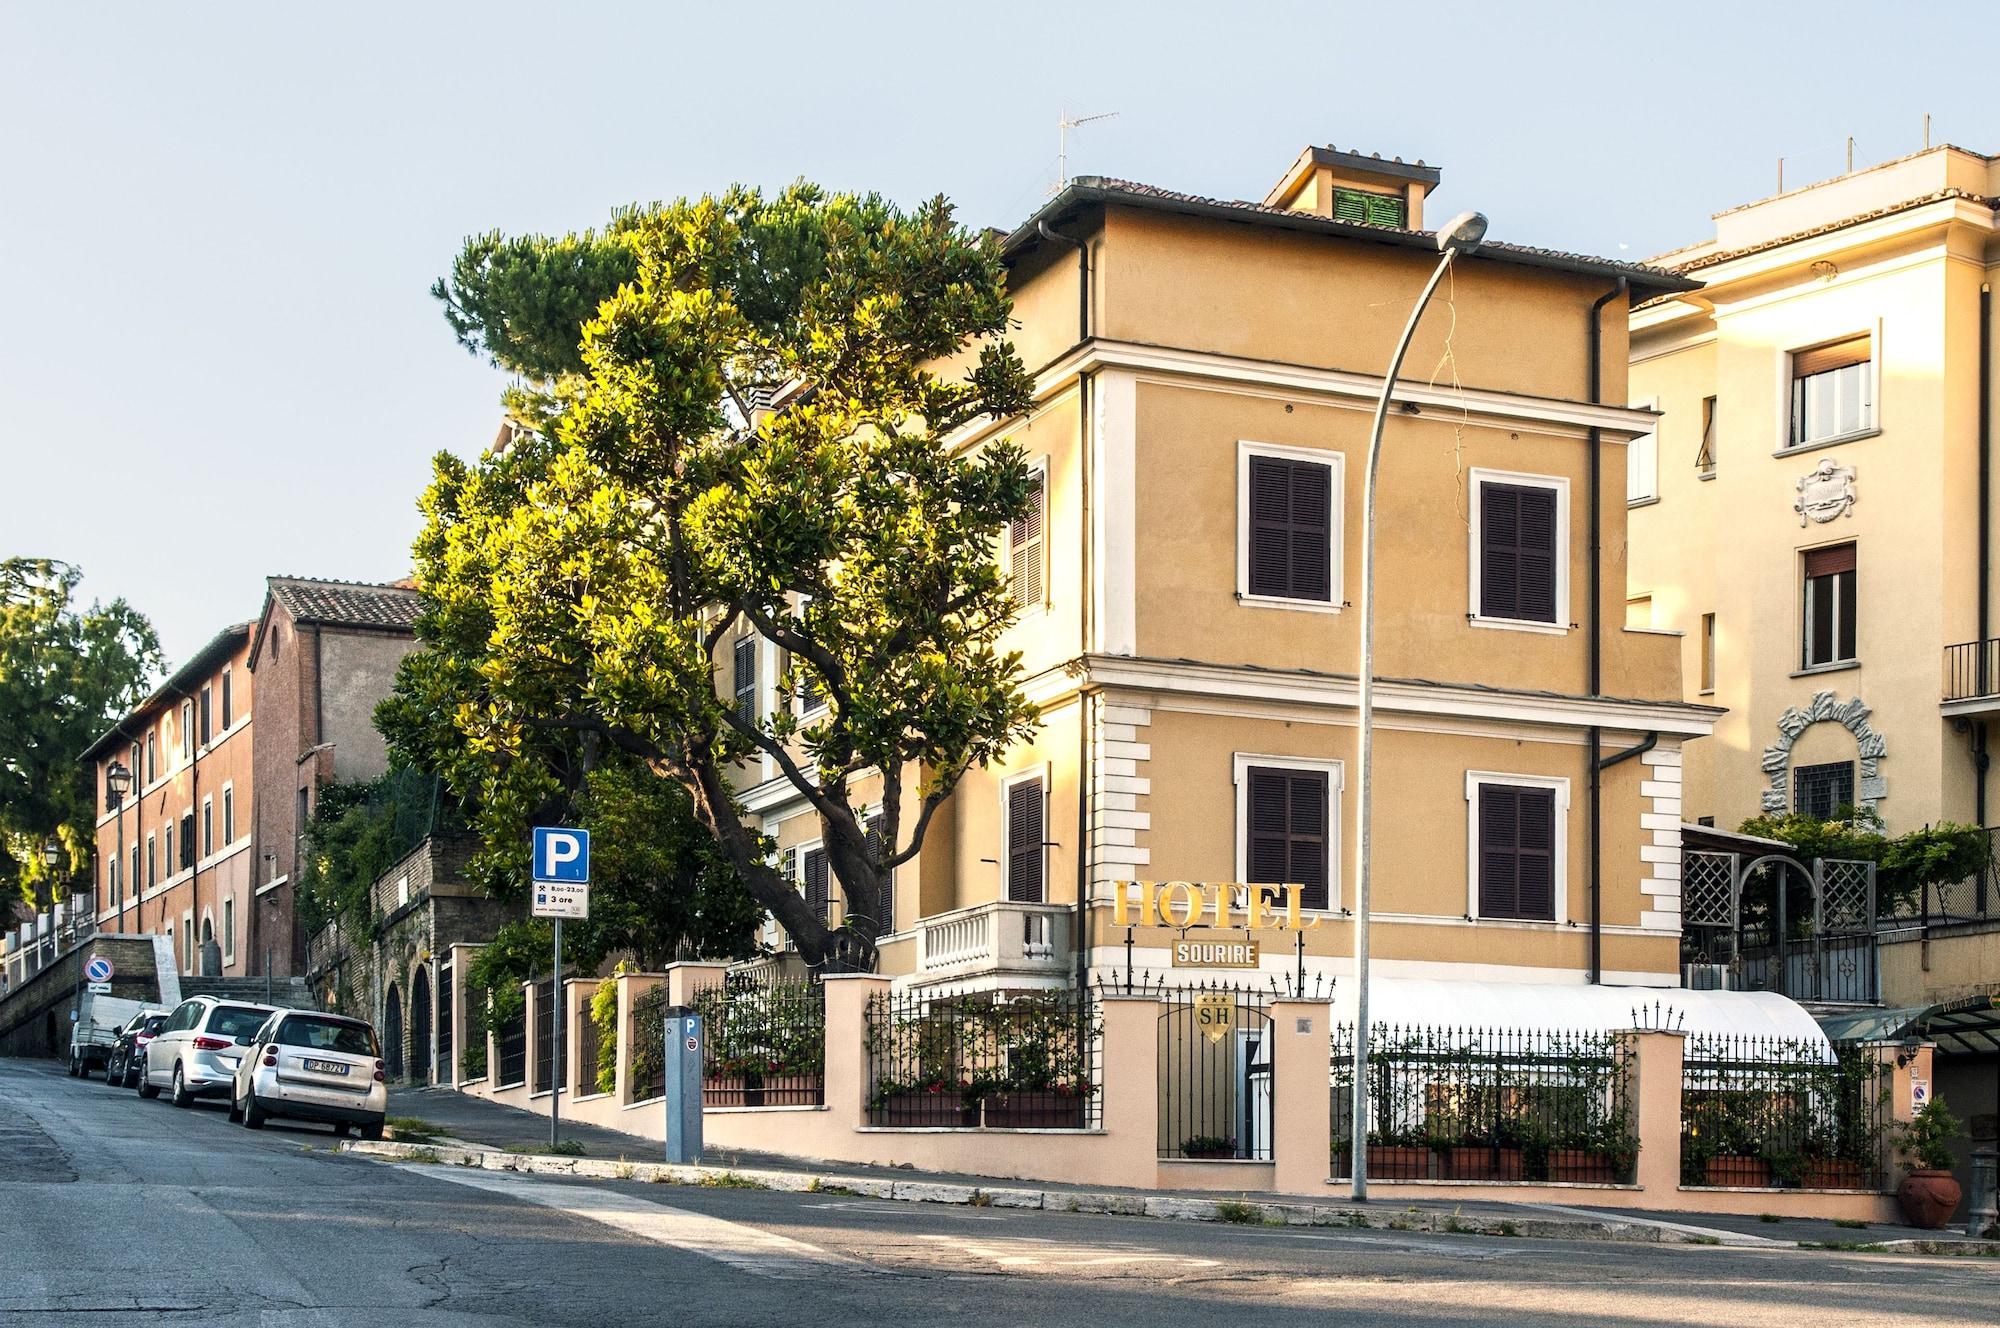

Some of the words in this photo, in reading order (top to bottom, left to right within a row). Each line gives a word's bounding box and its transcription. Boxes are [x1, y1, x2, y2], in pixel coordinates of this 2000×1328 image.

[546, 833, 580, 876] P
[1109, 880, 1321, 931] HOTEL
[1177, 944, 1255, 964] SOURIRE
[687, 1019, 695, 1033] P
